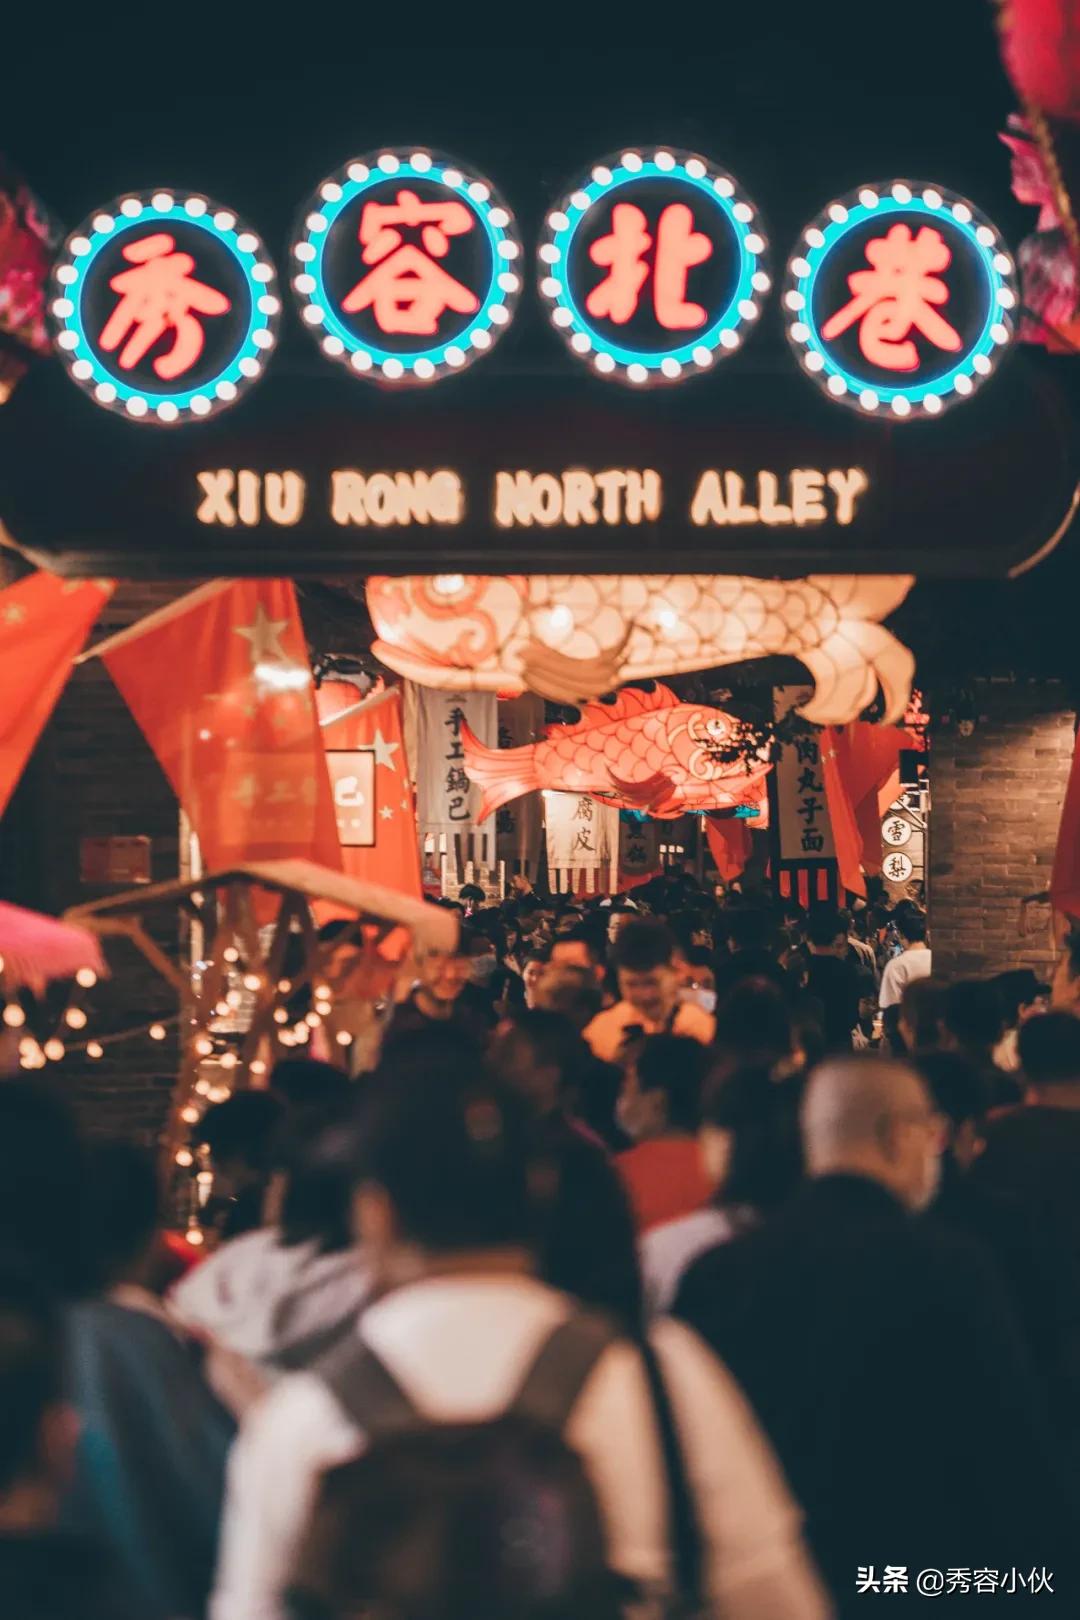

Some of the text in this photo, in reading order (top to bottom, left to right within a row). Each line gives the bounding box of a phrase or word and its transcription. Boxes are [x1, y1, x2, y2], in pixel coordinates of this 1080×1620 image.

[98, 188, 963, 381] 秀容北巷
[195, 467, 869, 528] XIU RONG NORTH ALLEY
